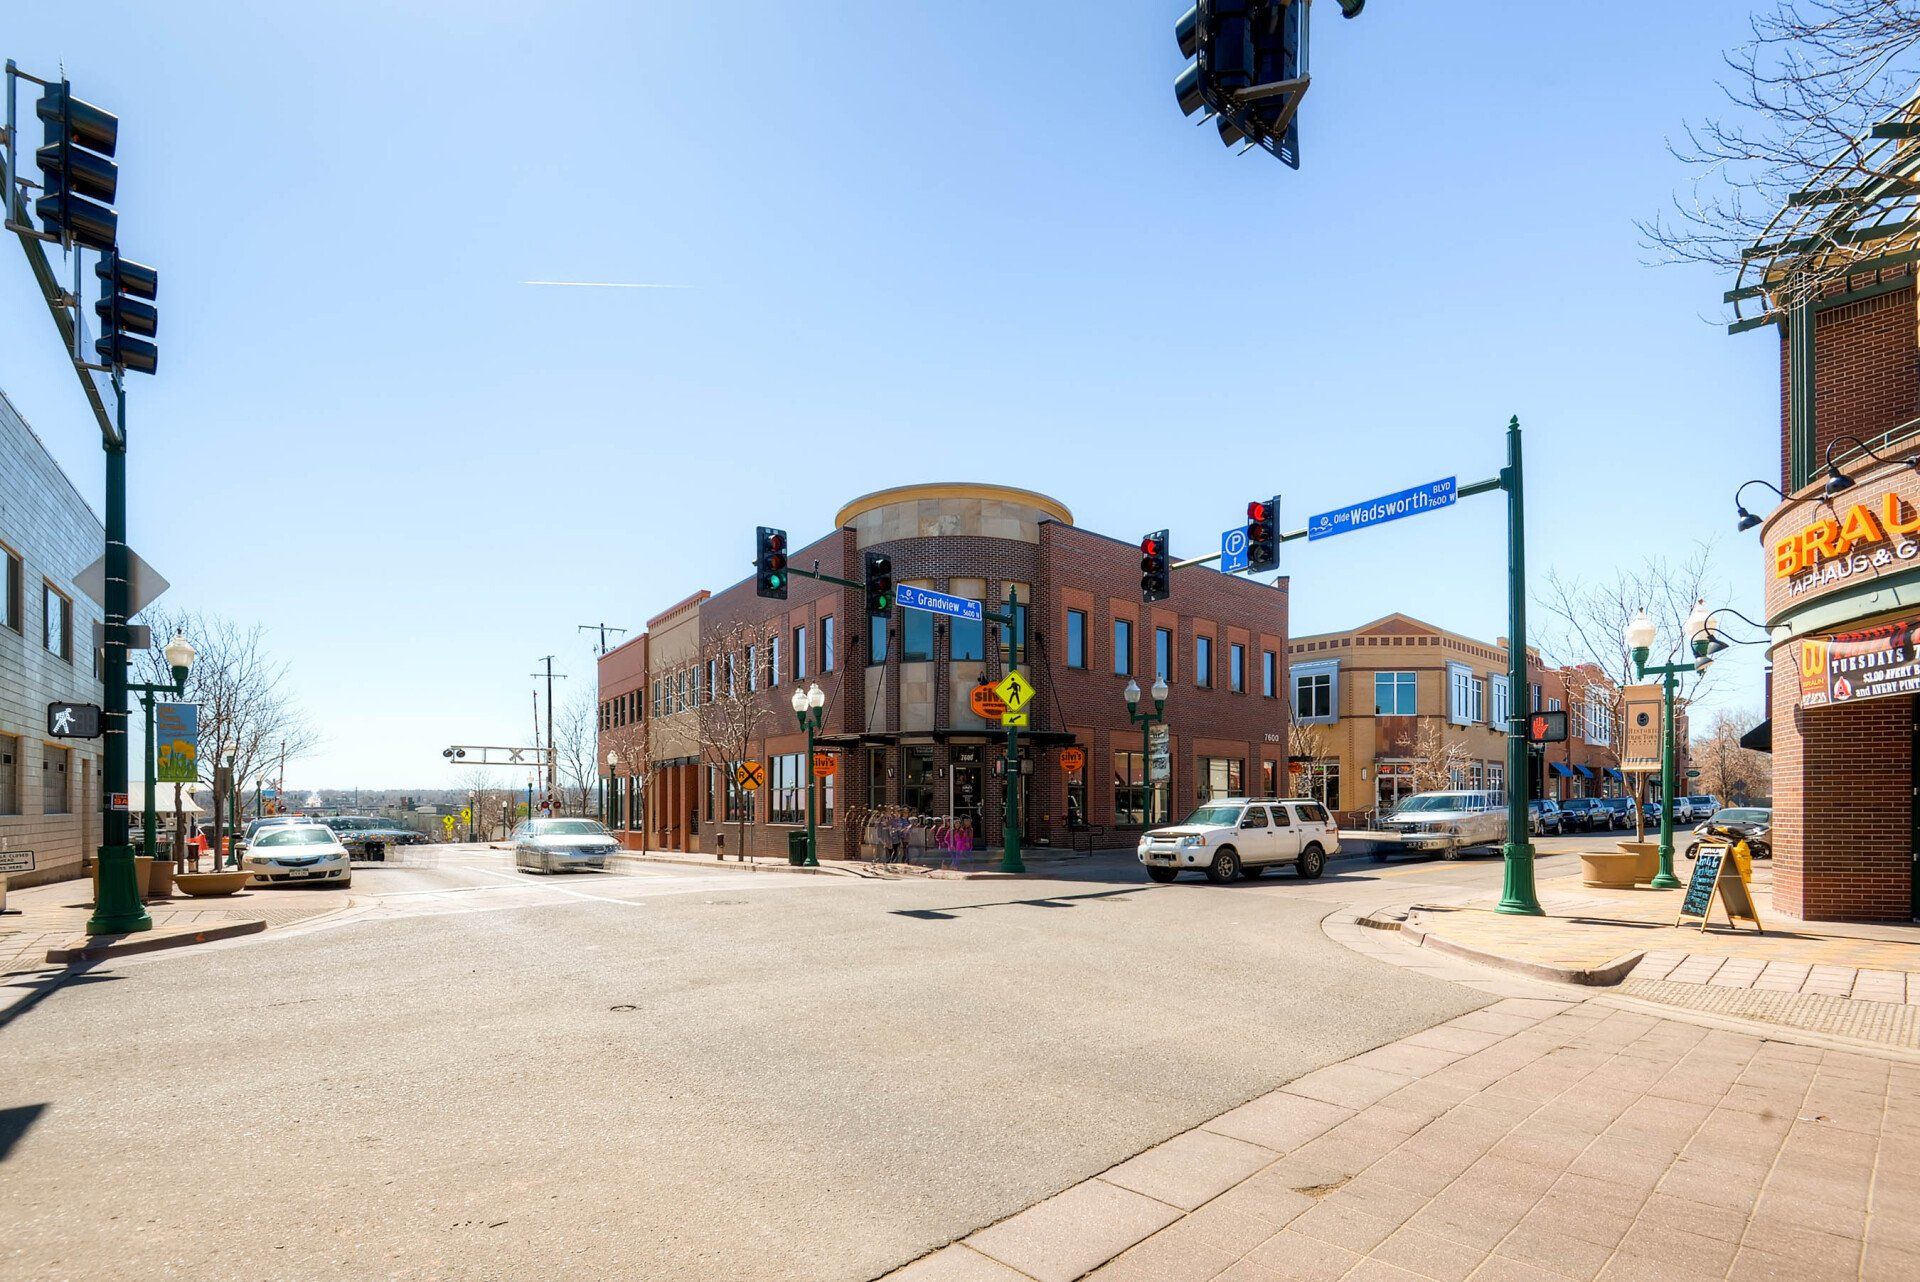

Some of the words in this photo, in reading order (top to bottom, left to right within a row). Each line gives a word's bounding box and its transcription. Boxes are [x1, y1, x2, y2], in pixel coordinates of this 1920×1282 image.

[1433, 481, 1450, 494] BLVD
[1333, 514, 1350, 524] Olde
[1350, 491, 1428, 525] Wadsworth
[1429, 495, 1447, 507] 7600
[1449, 493, 1456, 501] W
[1231, 534, 1241, 551] P
[1788, 554, 1869, 597] TAPHAUS
[1872, 548, 1891, 567] &
[917, 593, 960, 612] Grandview
[962, 609, 976, 617] 5600
[1831, 647, 1904, 674] TUESDAYS
[1885, 664, 1912, 680] AVERY
[1855, 685, 1871, 698] and
[1872, 680, 1898, 696] AVERY
[1264, 733, 1279, 742] 7600
[1061, 751, 1082, 761] silvi's
